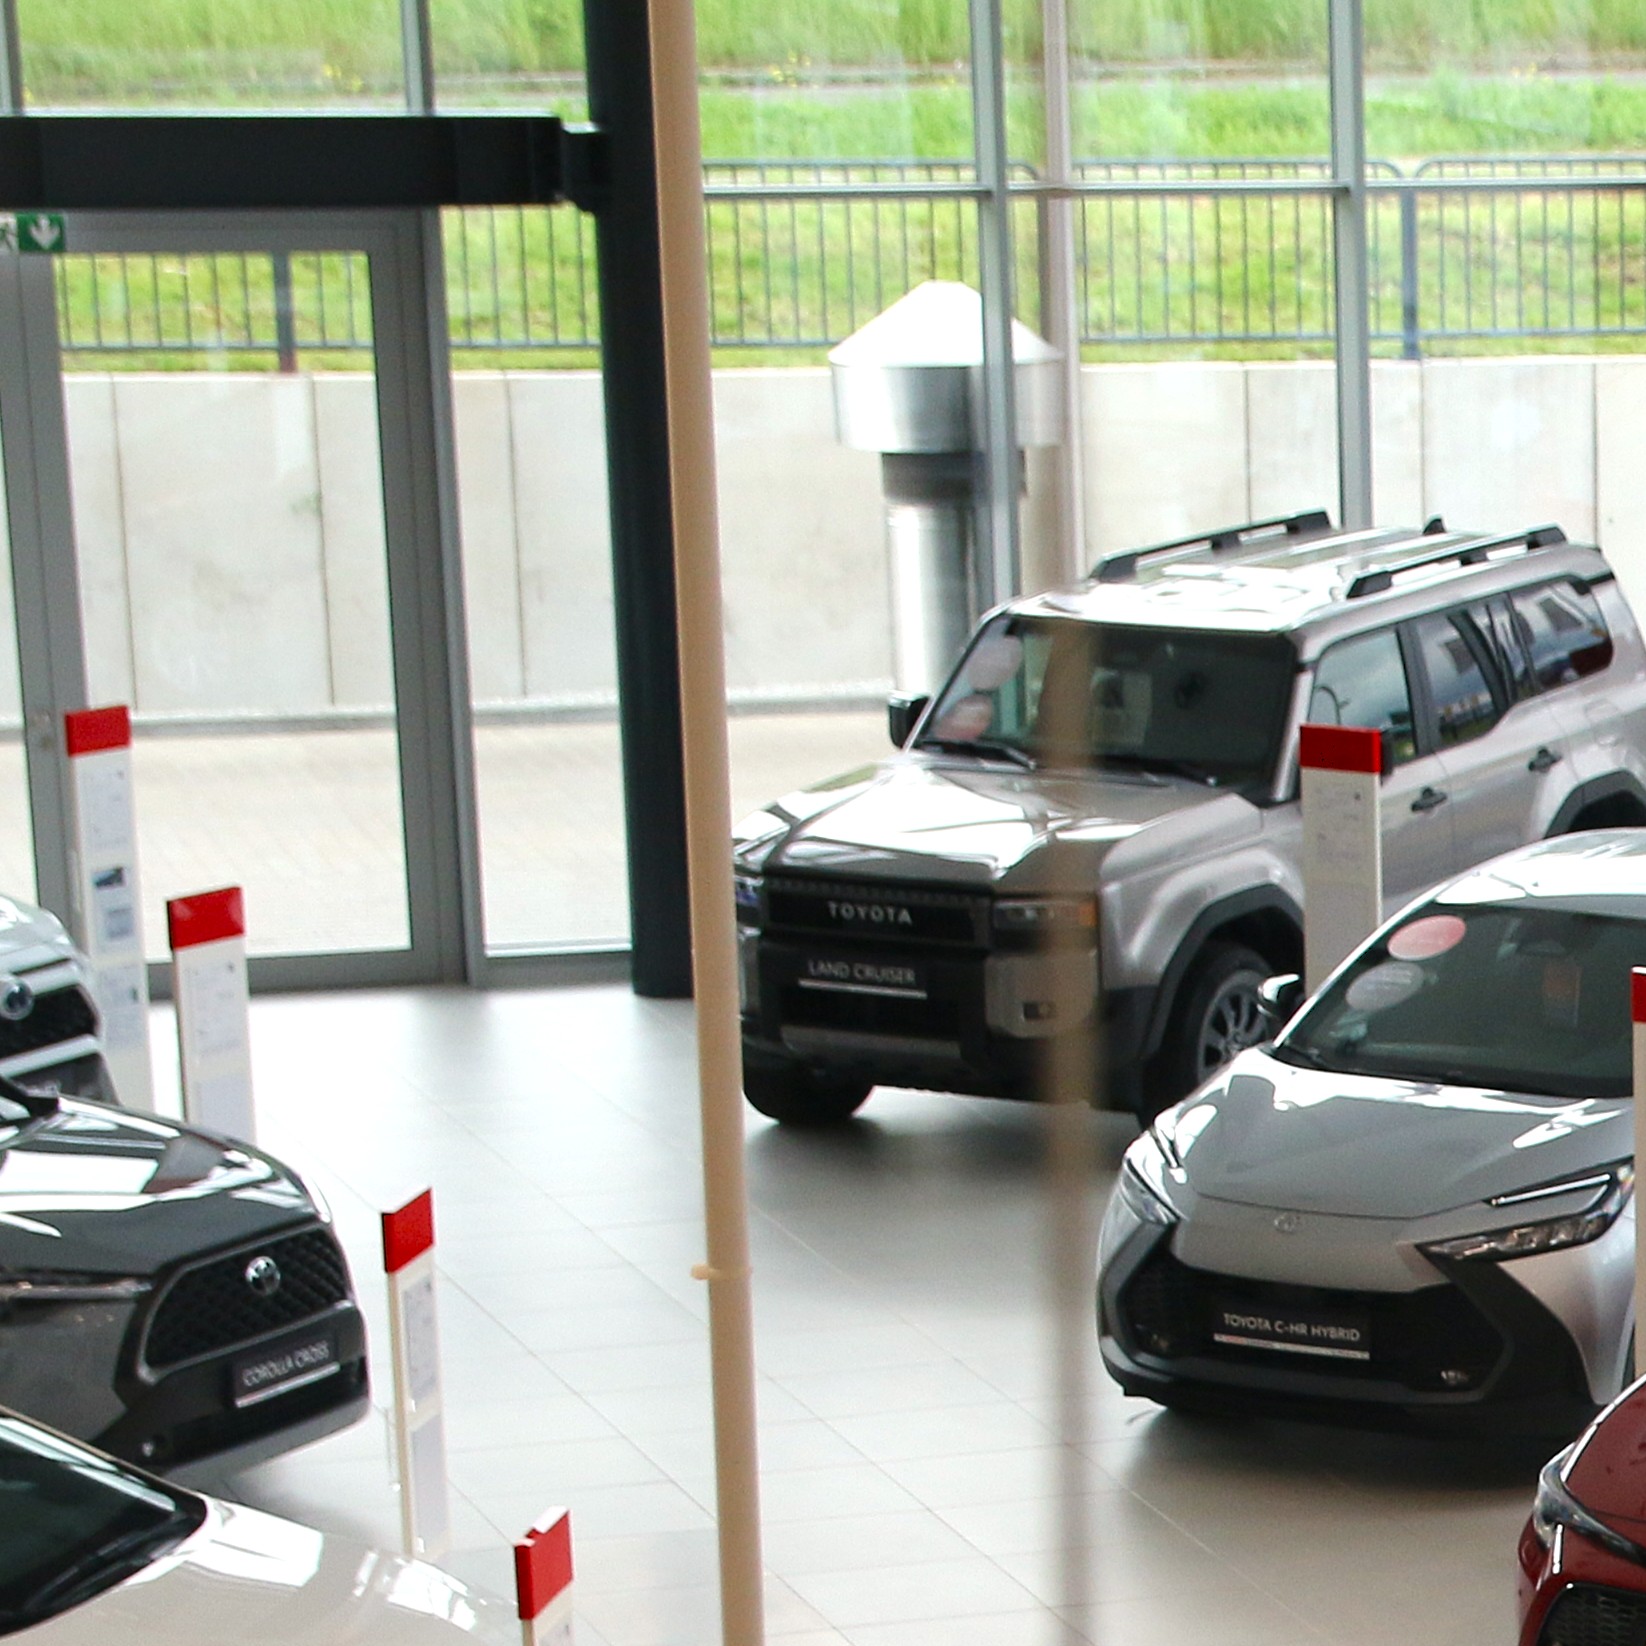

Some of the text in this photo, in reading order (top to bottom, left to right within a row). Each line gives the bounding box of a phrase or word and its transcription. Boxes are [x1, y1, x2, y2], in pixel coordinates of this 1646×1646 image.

[828, 900, 913, 926] TOYOTA
[807, 958, 917, 985] LAND CRUISER
[1223, 1312, 1361, 1342] TOYOTA C-HR HYBRID
